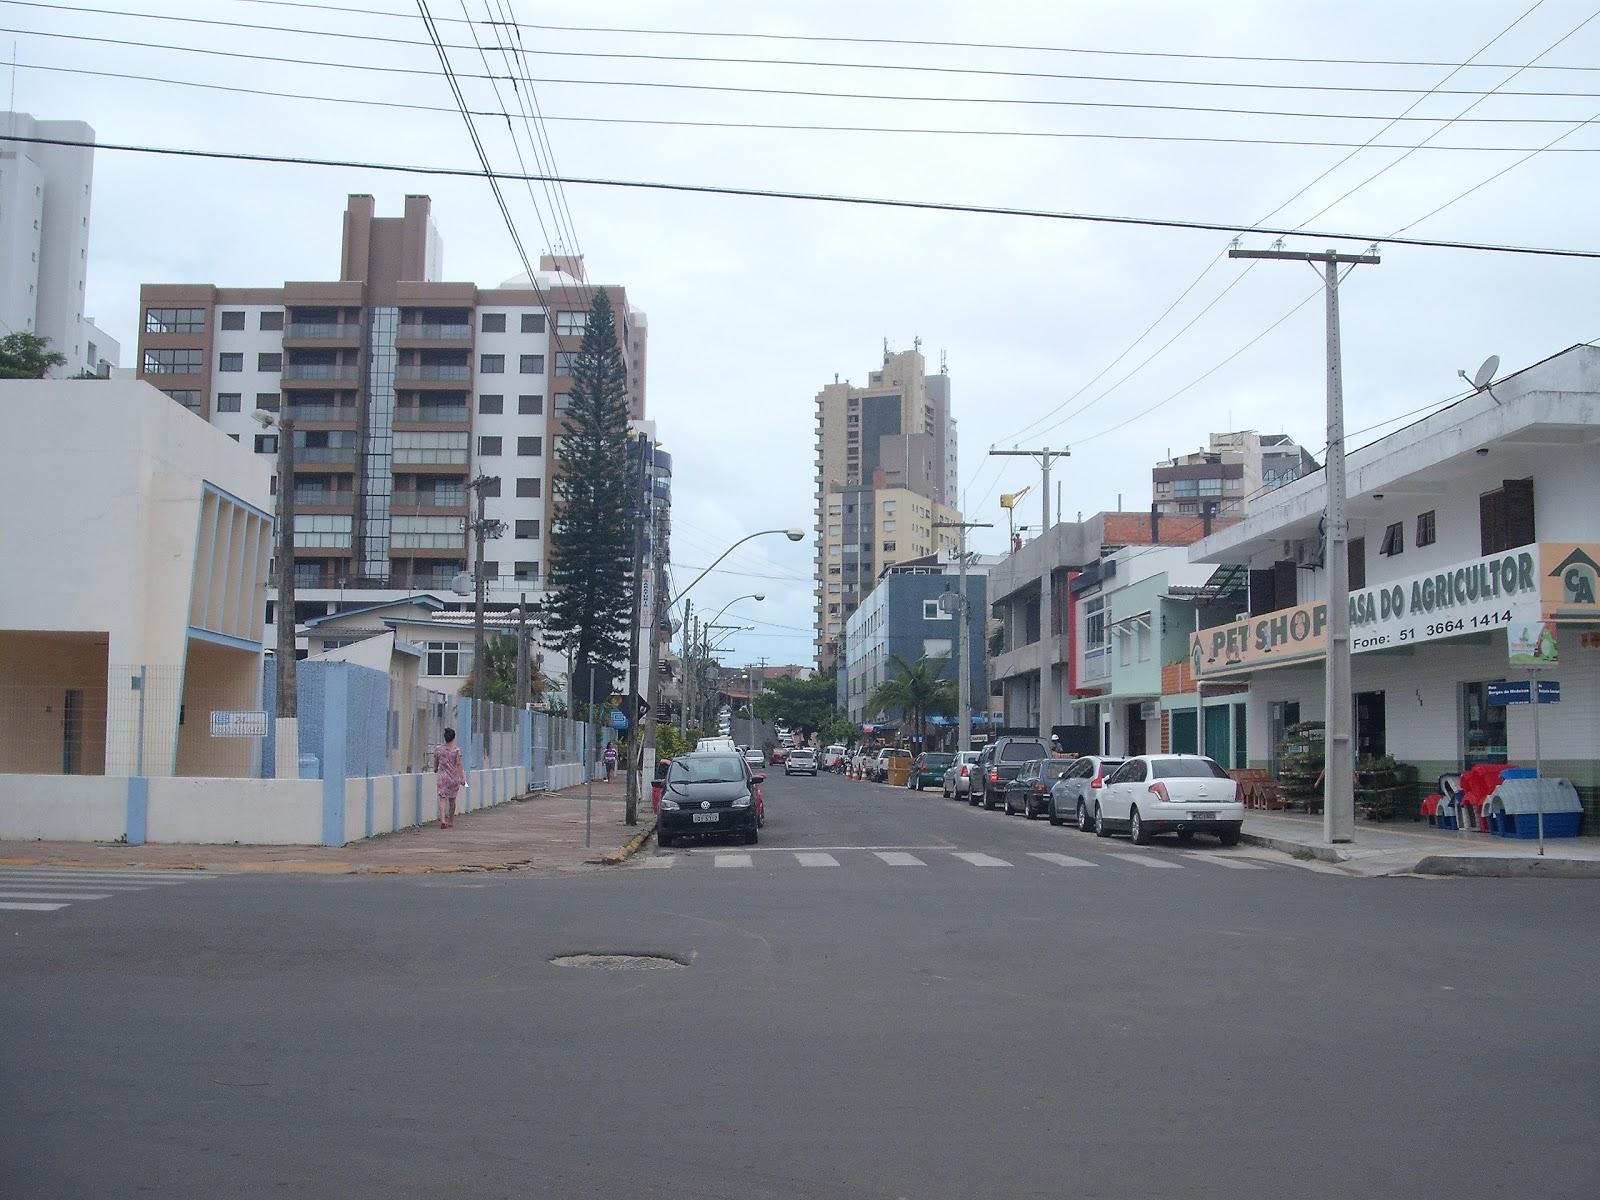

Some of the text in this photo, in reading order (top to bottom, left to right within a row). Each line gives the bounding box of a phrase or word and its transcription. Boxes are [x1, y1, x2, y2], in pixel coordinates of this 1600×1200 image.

[1349, 552, 1536, 627] ASA DO AGRICULTOR
[1213, 604, 1328, 658] PET SHOP
[1353, 609, 1513, 649] Fone: 51 3664 1414
